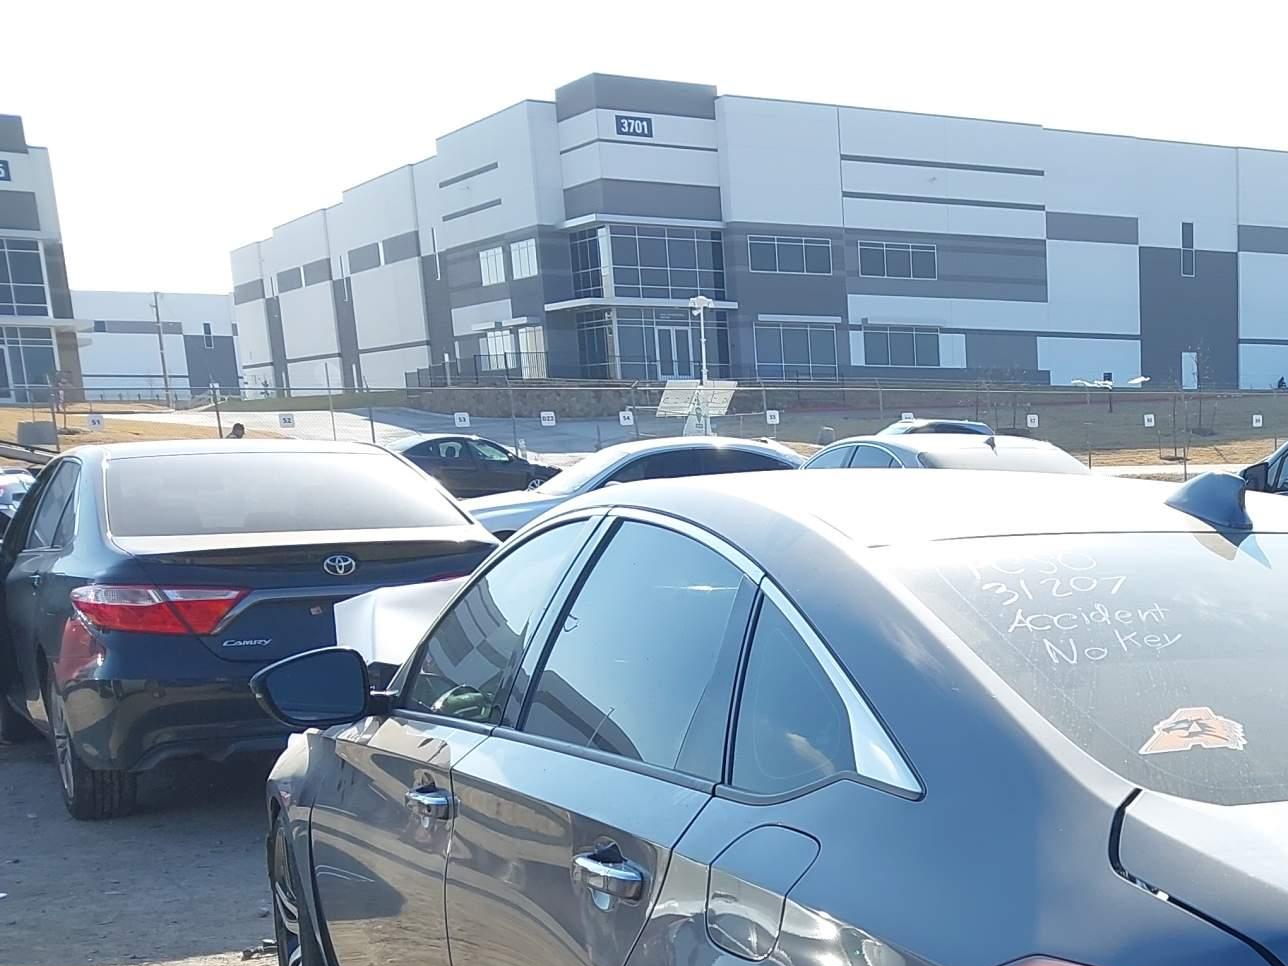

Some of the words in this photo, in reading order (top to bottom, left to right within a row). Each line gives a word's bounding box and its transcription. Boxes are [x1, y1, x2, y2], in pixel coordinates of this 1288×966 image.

[620, 118, 649, 135] 3701
[223, 638, 272, 647] CAMRY
[1043, 637, 1108, 665] No
[1114, 629, 1183, 651] Key
